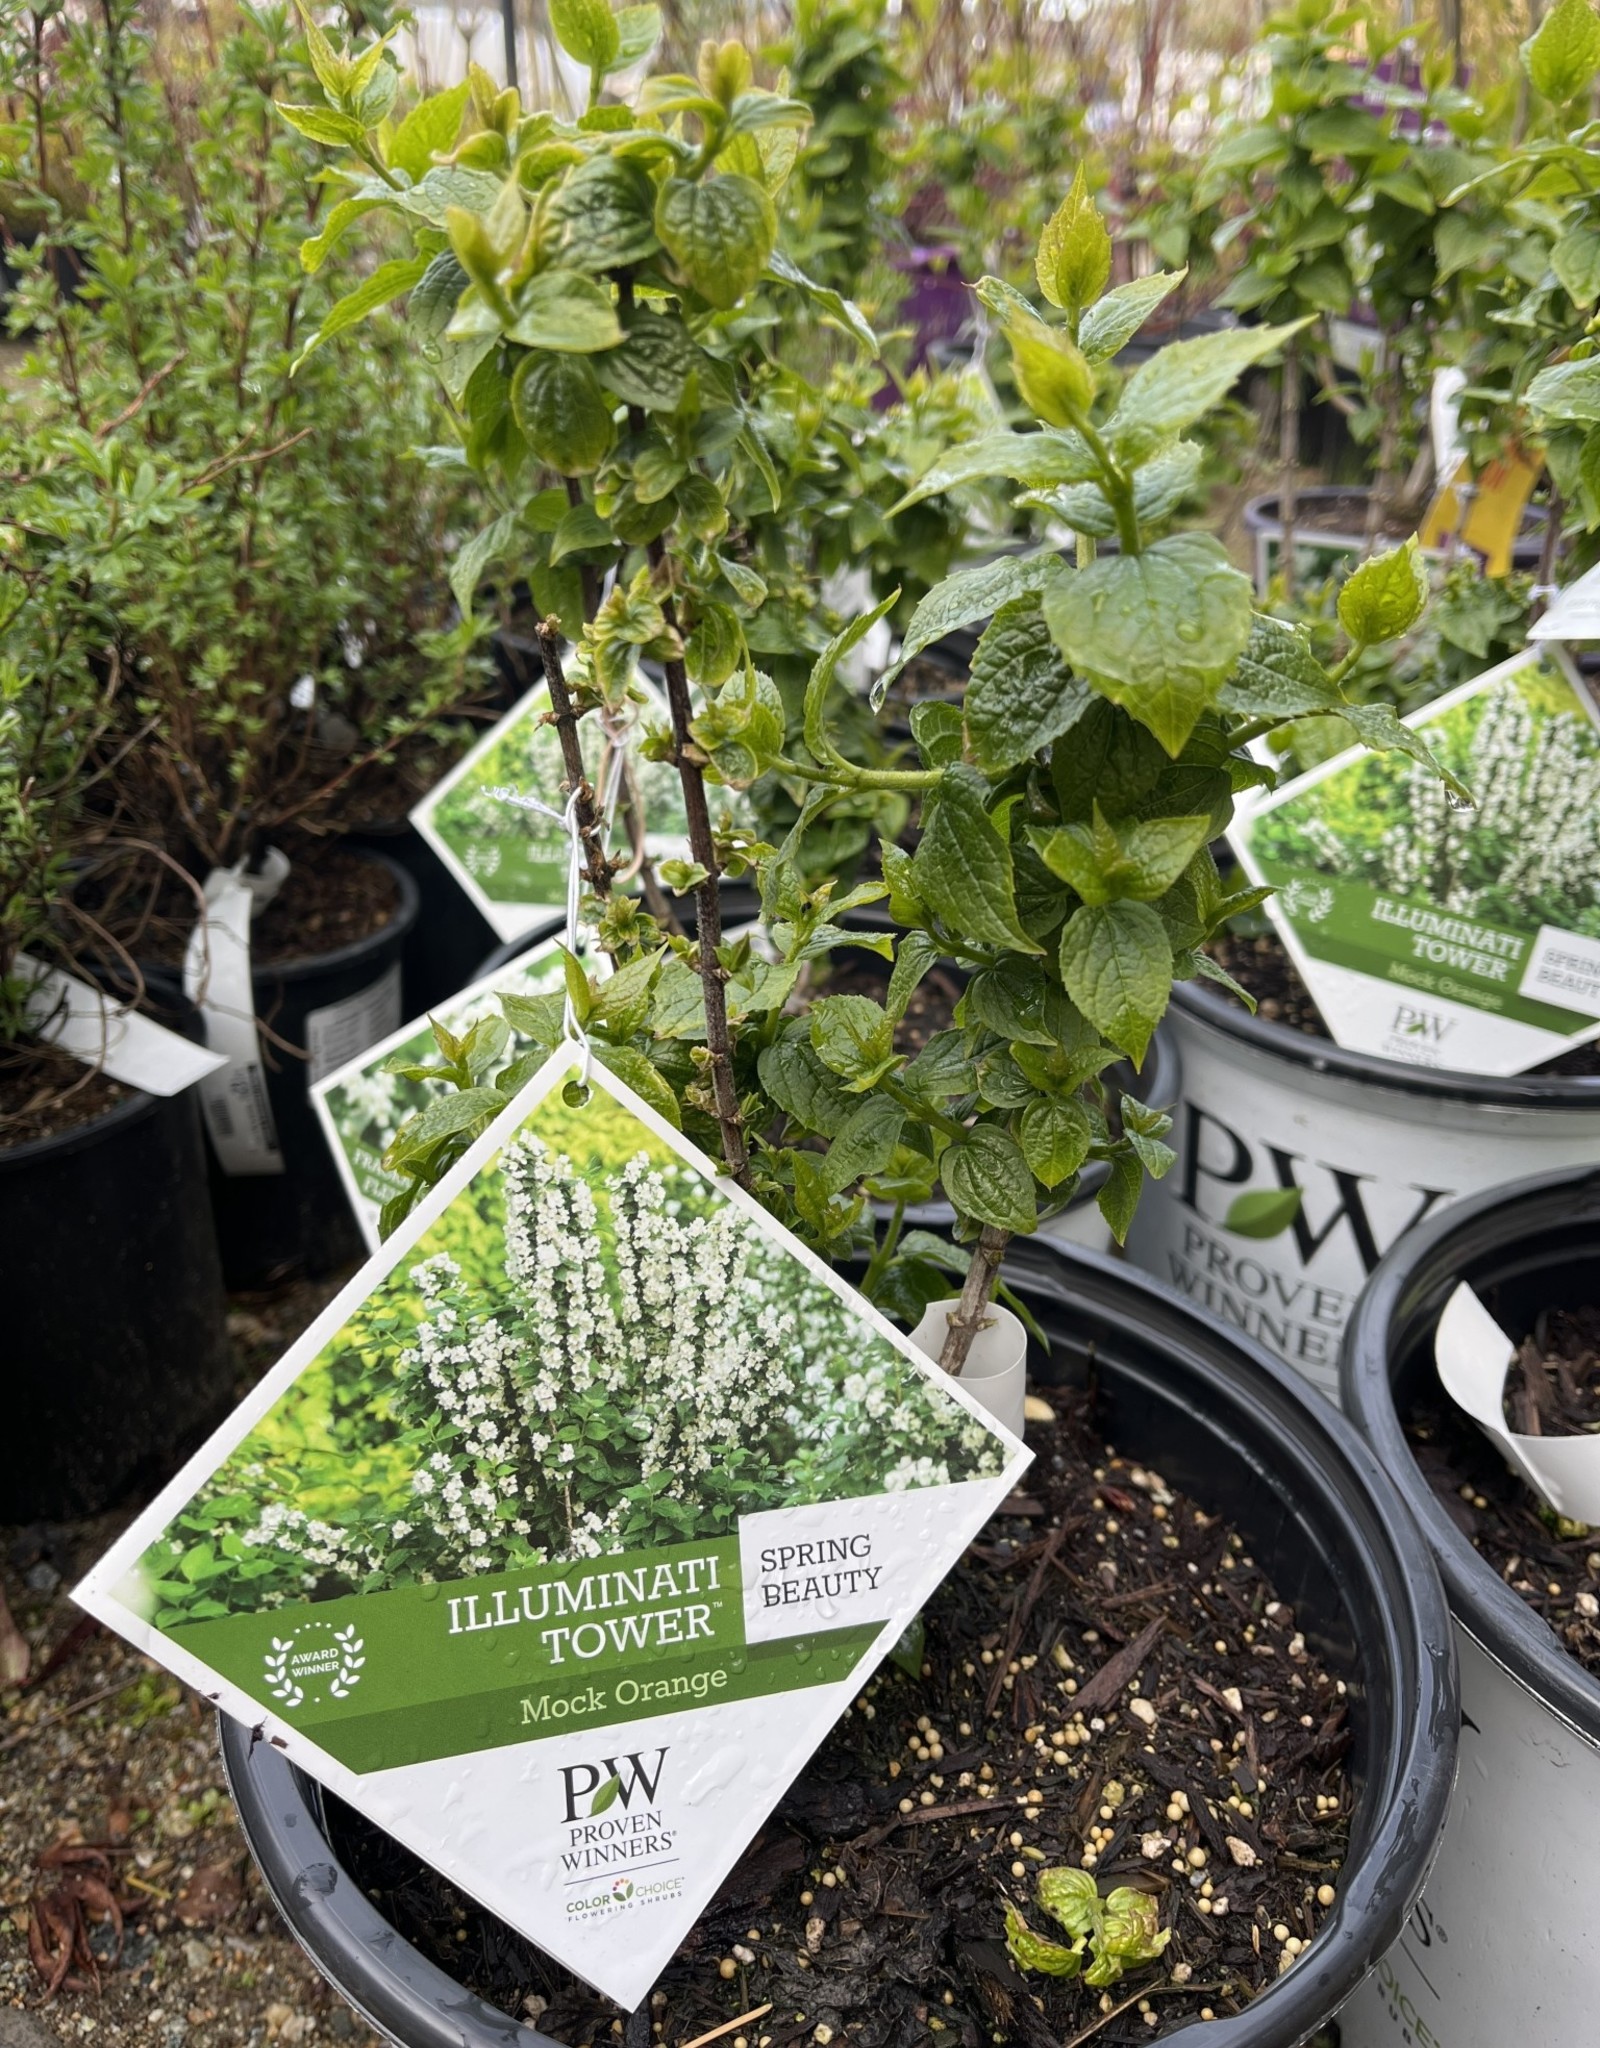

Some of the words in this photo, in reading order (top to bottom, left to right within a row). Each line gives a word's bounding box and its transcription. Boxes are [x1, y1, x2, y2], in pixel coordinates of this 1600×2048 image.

[1371, 897, 1525, 960] ILLUMINATI
[1536, 966, 1600, 998] BEAUT
[1173, 1098, 1457, 1277] PW
[1184, 1223, 1358, 1327] PROVE
[1167, 1250, 1340, 1370] WINNE
[761, 1534, 871, 1573] SPRING
[447, 1556, 720, 1634] ILLUMINATI
[762, 1566, 882, 1608] BEAUTY
[291, 1648, 339, 1665] AWARD
[291, 1661, 340, 1677] WINNER
[520, 1688, 606, 1725] Mock
[615, 1669, 728, 1706] Orange
[557, 1746, 671, 1824] PW
[569, 1810, 662, 1847] PROVEN
[566, 1895, 610, 1913] COLOR
[568, 1902, 633, 1922] FLOWERING
[641, 1891, 682, 1906] SHRUBS
